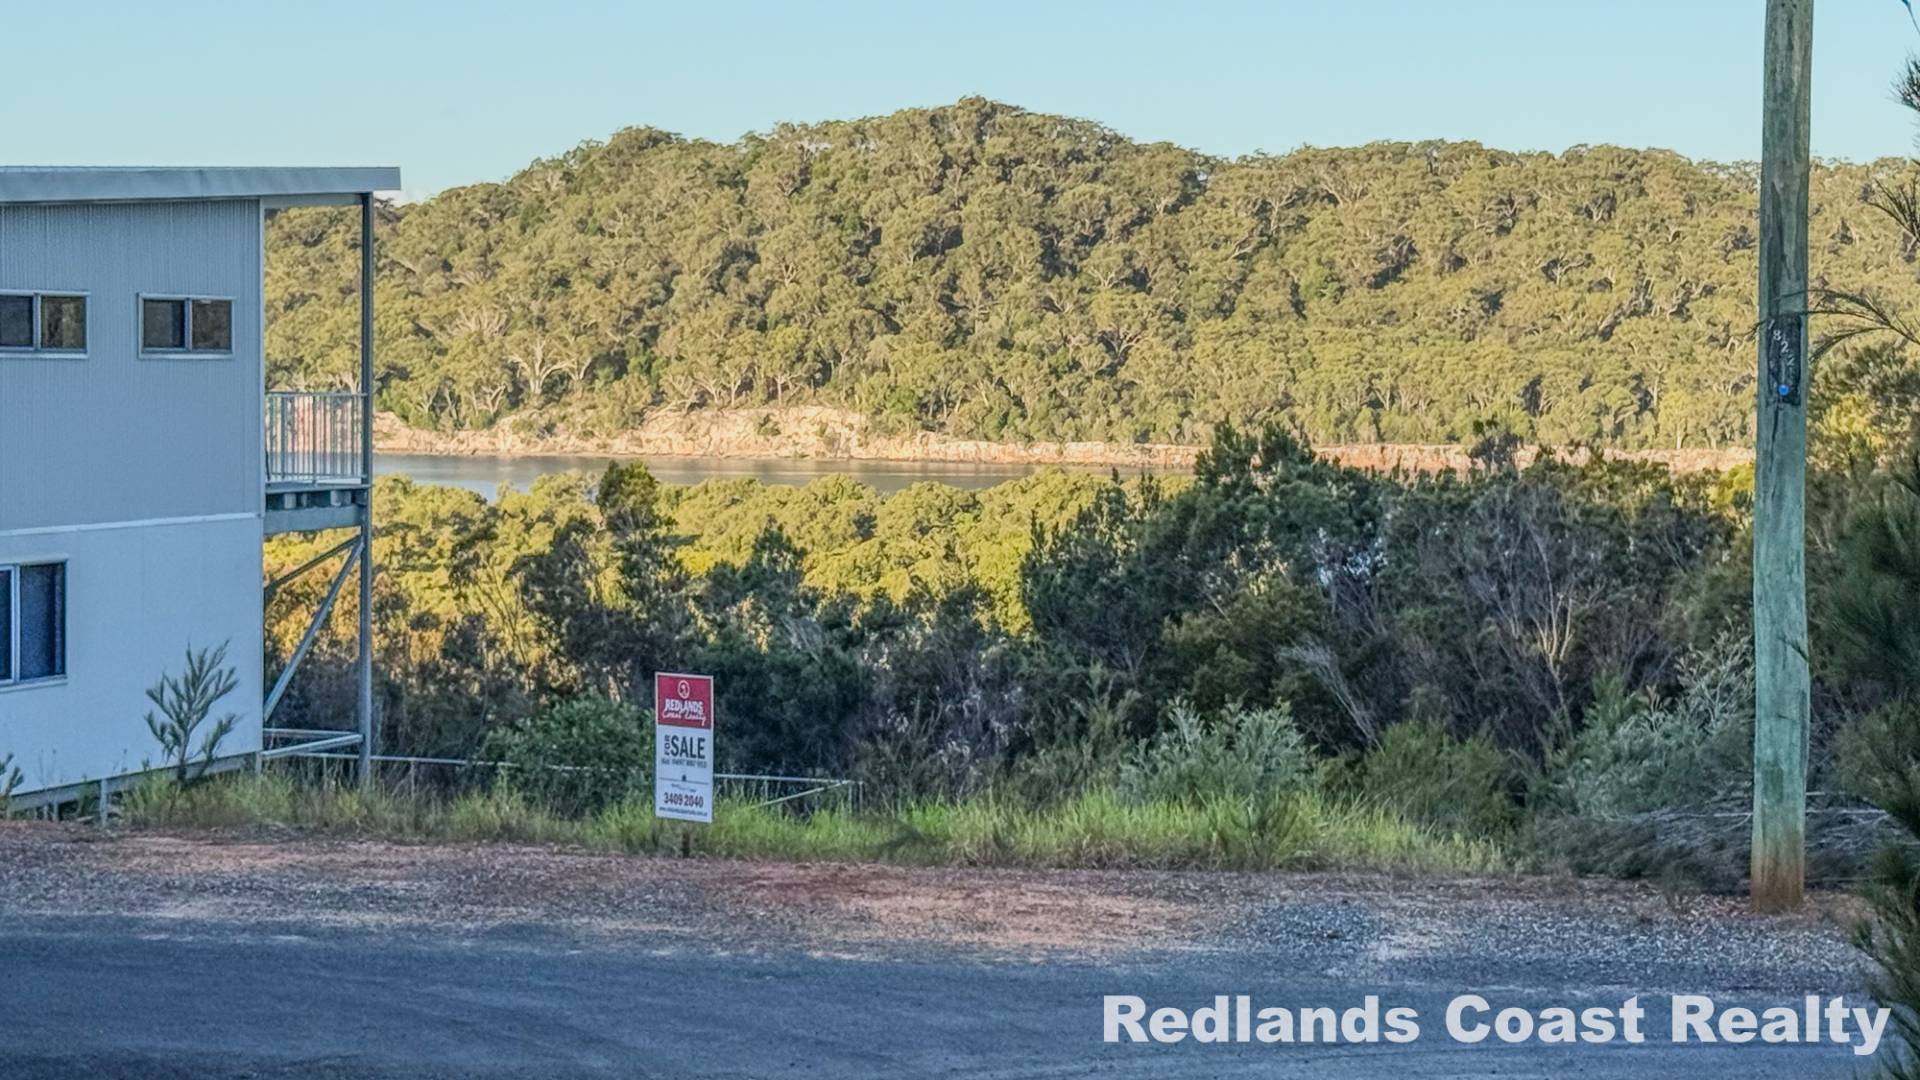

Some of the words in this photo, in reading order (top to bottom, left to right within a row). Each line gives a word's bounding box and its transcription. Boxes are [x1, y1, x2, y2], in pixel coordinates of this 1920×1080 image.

[664, 698, 704, 714] REDLANDS
[670, 735, 706, 759] SALE
[664, 792, 683, 806] 3409
